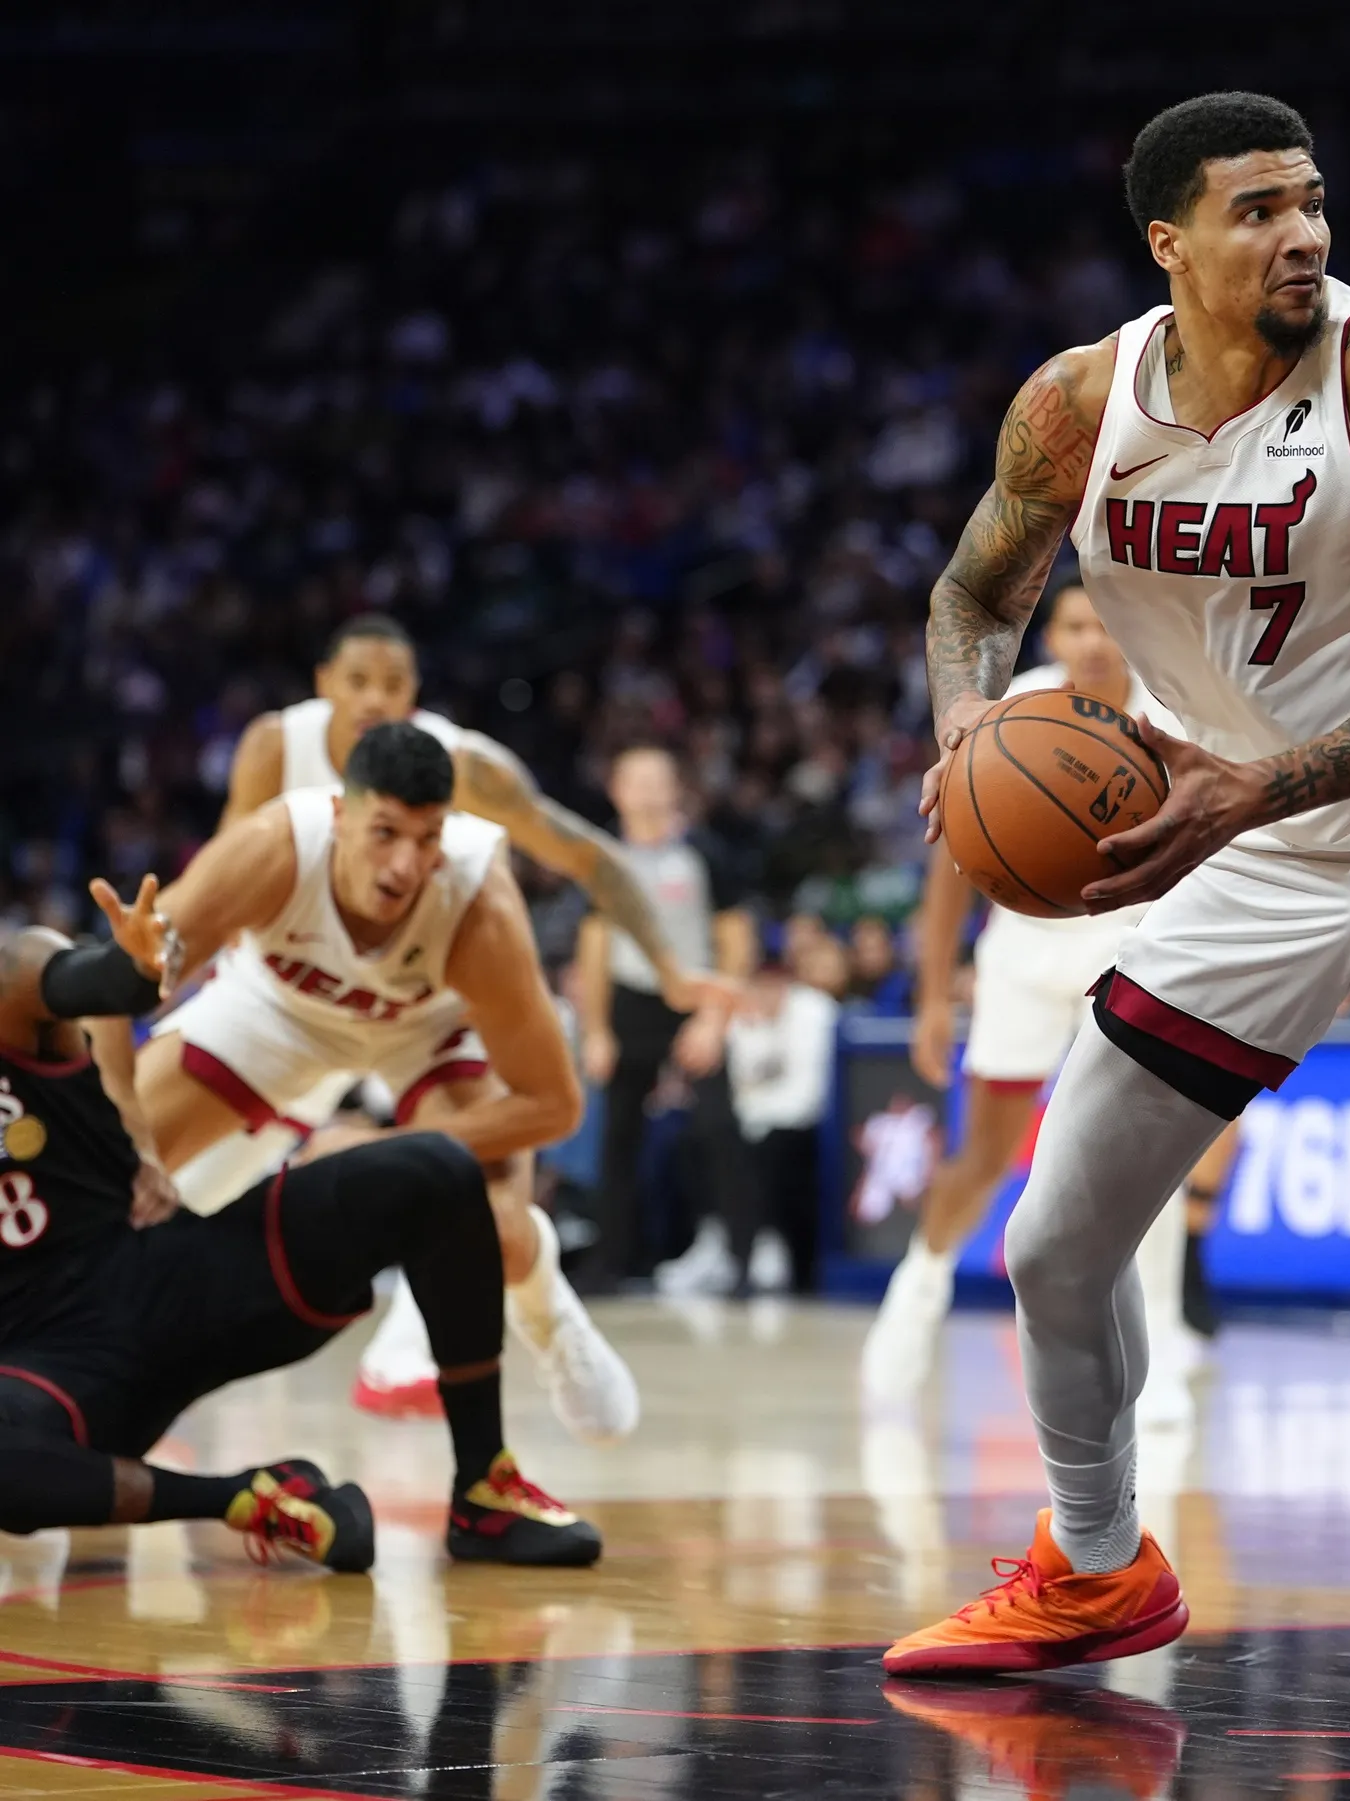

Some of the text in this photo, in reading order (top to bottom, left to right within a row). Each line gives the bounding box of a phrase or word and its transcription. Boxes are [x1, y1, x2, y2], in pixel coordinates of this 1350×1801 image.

[1266, 443, 1325, 458] Robinhood
[1106, 468, 1318, 578] HEAT
[1247, 581, 1307, 665] 7
